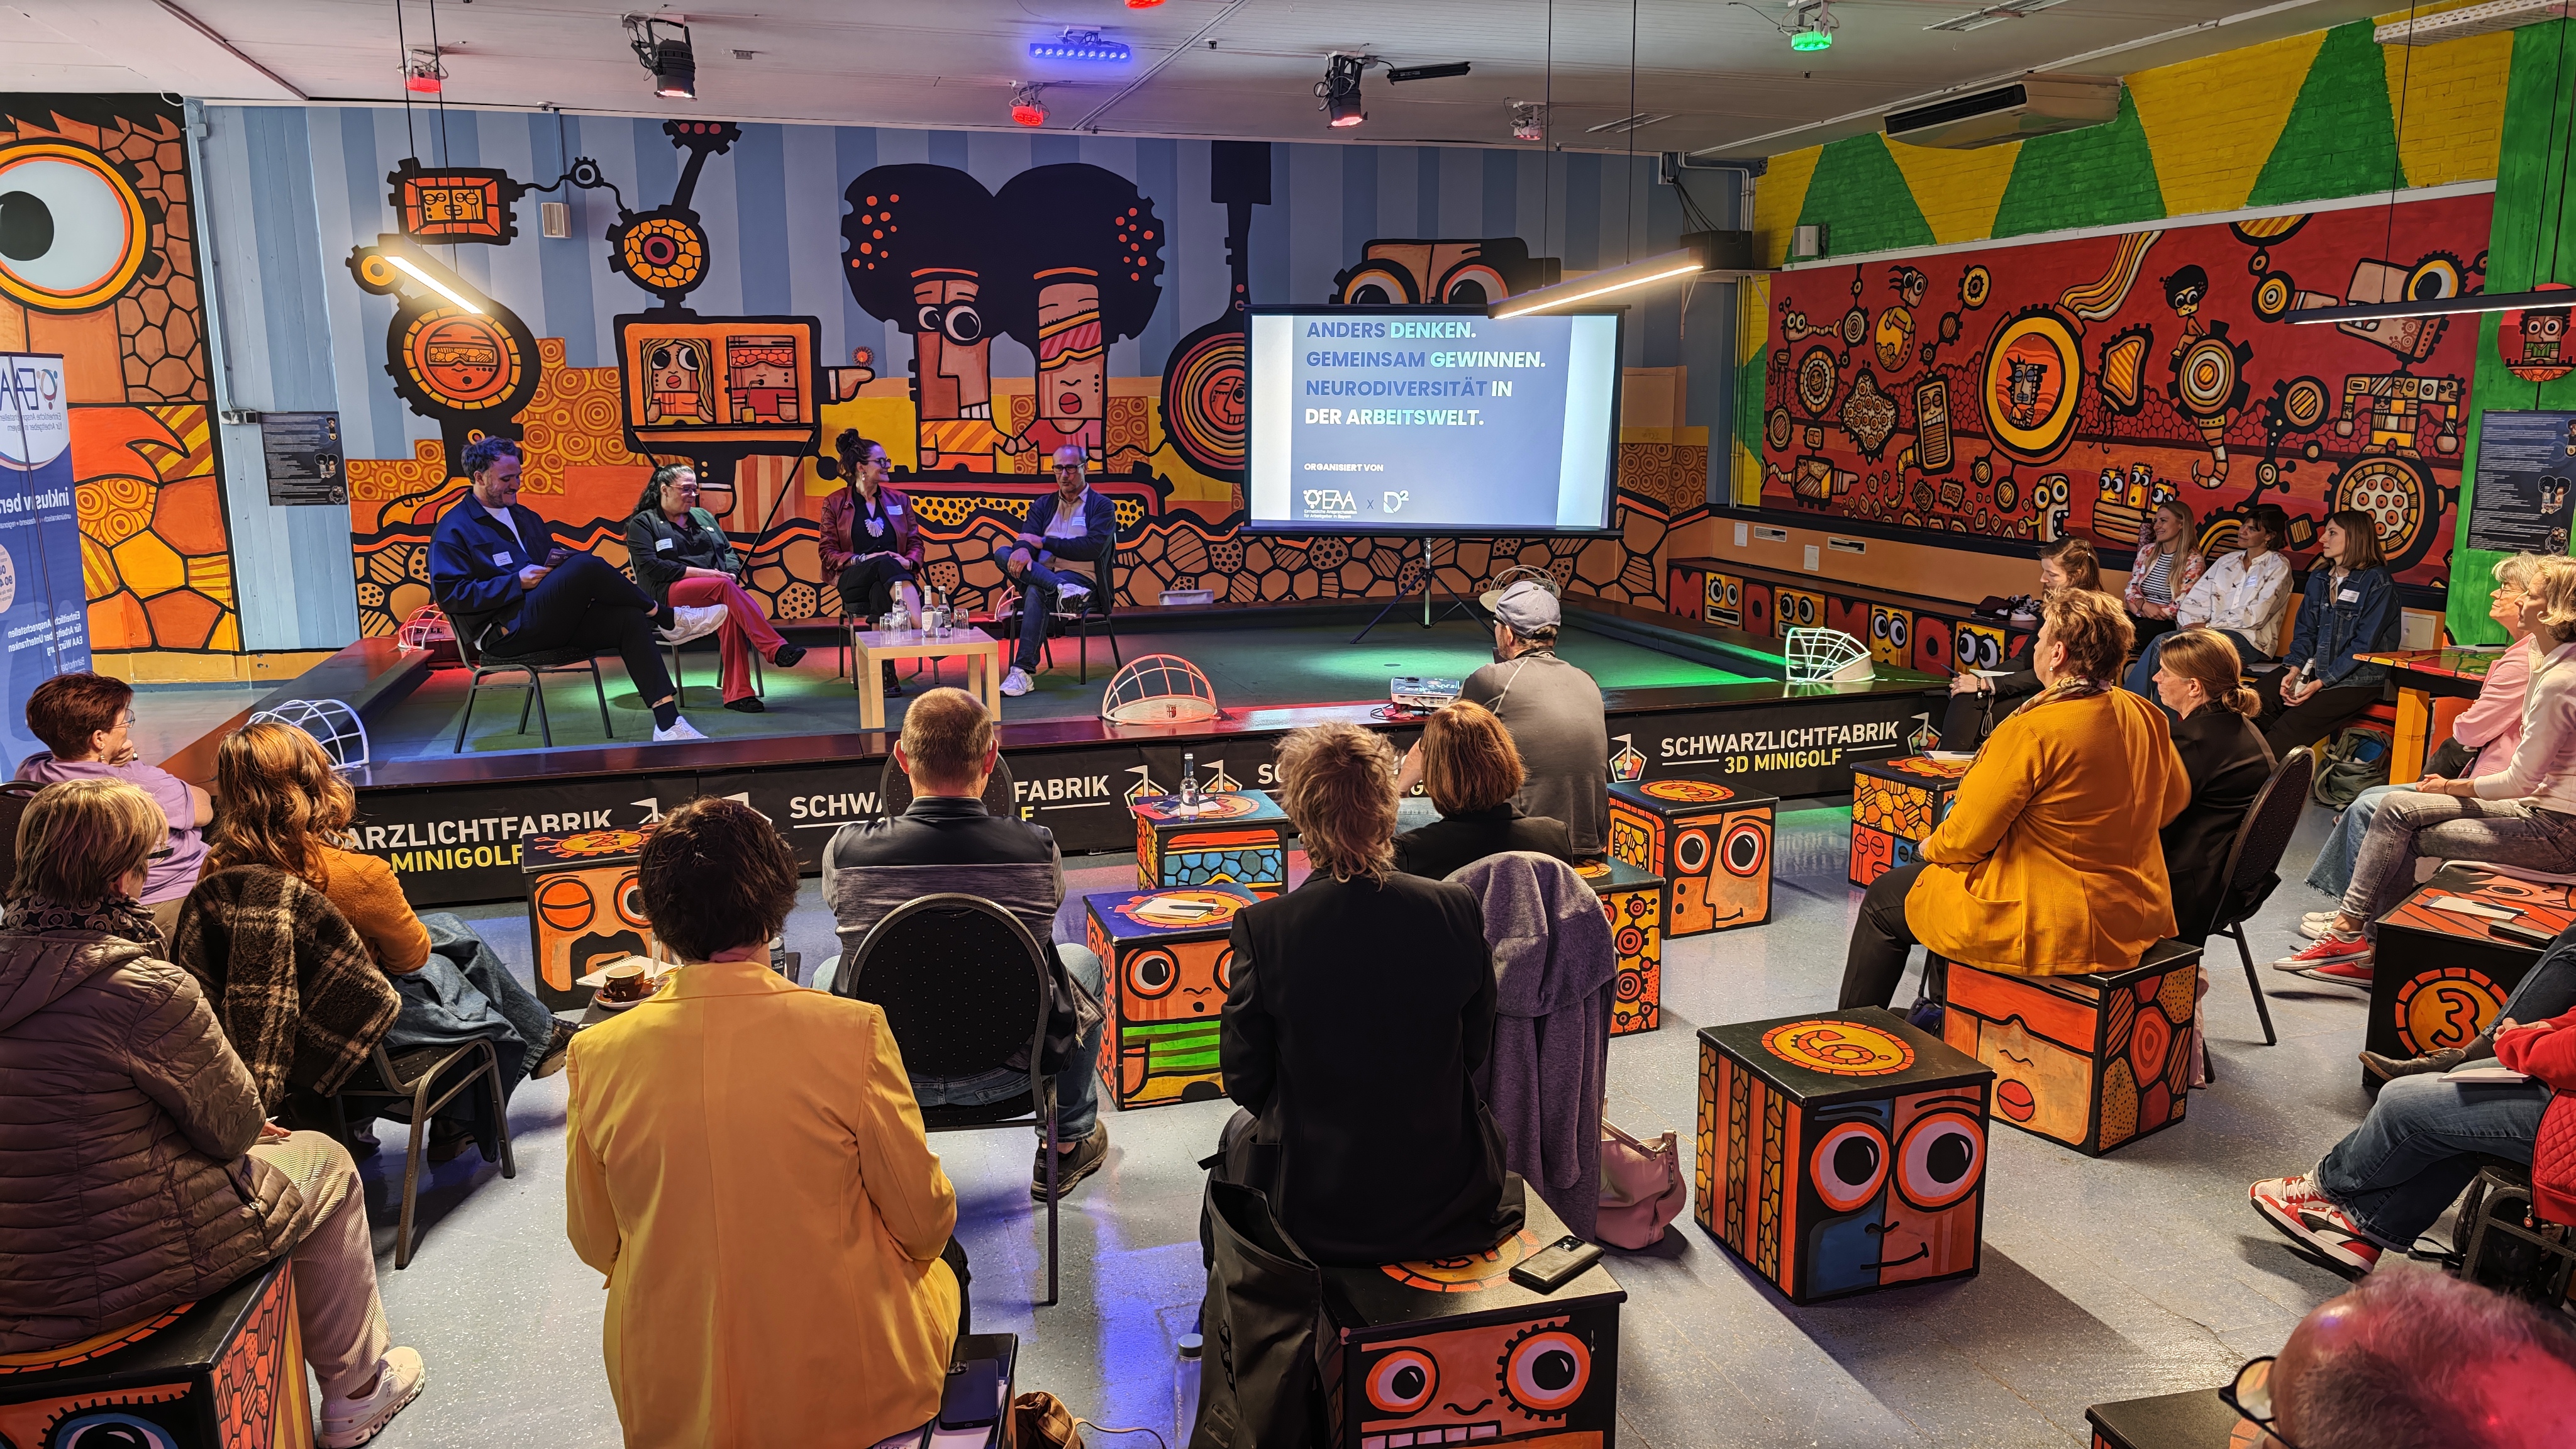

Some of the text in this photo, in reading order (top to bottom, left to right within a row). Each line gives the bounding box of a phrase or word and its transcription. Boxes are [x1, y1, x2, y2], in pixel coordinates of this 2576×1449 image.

[1306, 321, 1477, 339] ANDERS DENKEN.
[1306, 351, 1546, 369] GEMEINSAM GEWINNEN.
[1306, 377, 1513, 397] NEURODIVERSITÄT IN
[1305, 408, 1484, 426] DER ARBEITSWELT.
[1304, 464, 1384, 472] ORGANISIERT VON
[1660, 721, 1899, 757] SCHWARZLICHTFABRIK
[1724, 748, 1843, 774] 3D MINIGOLF
